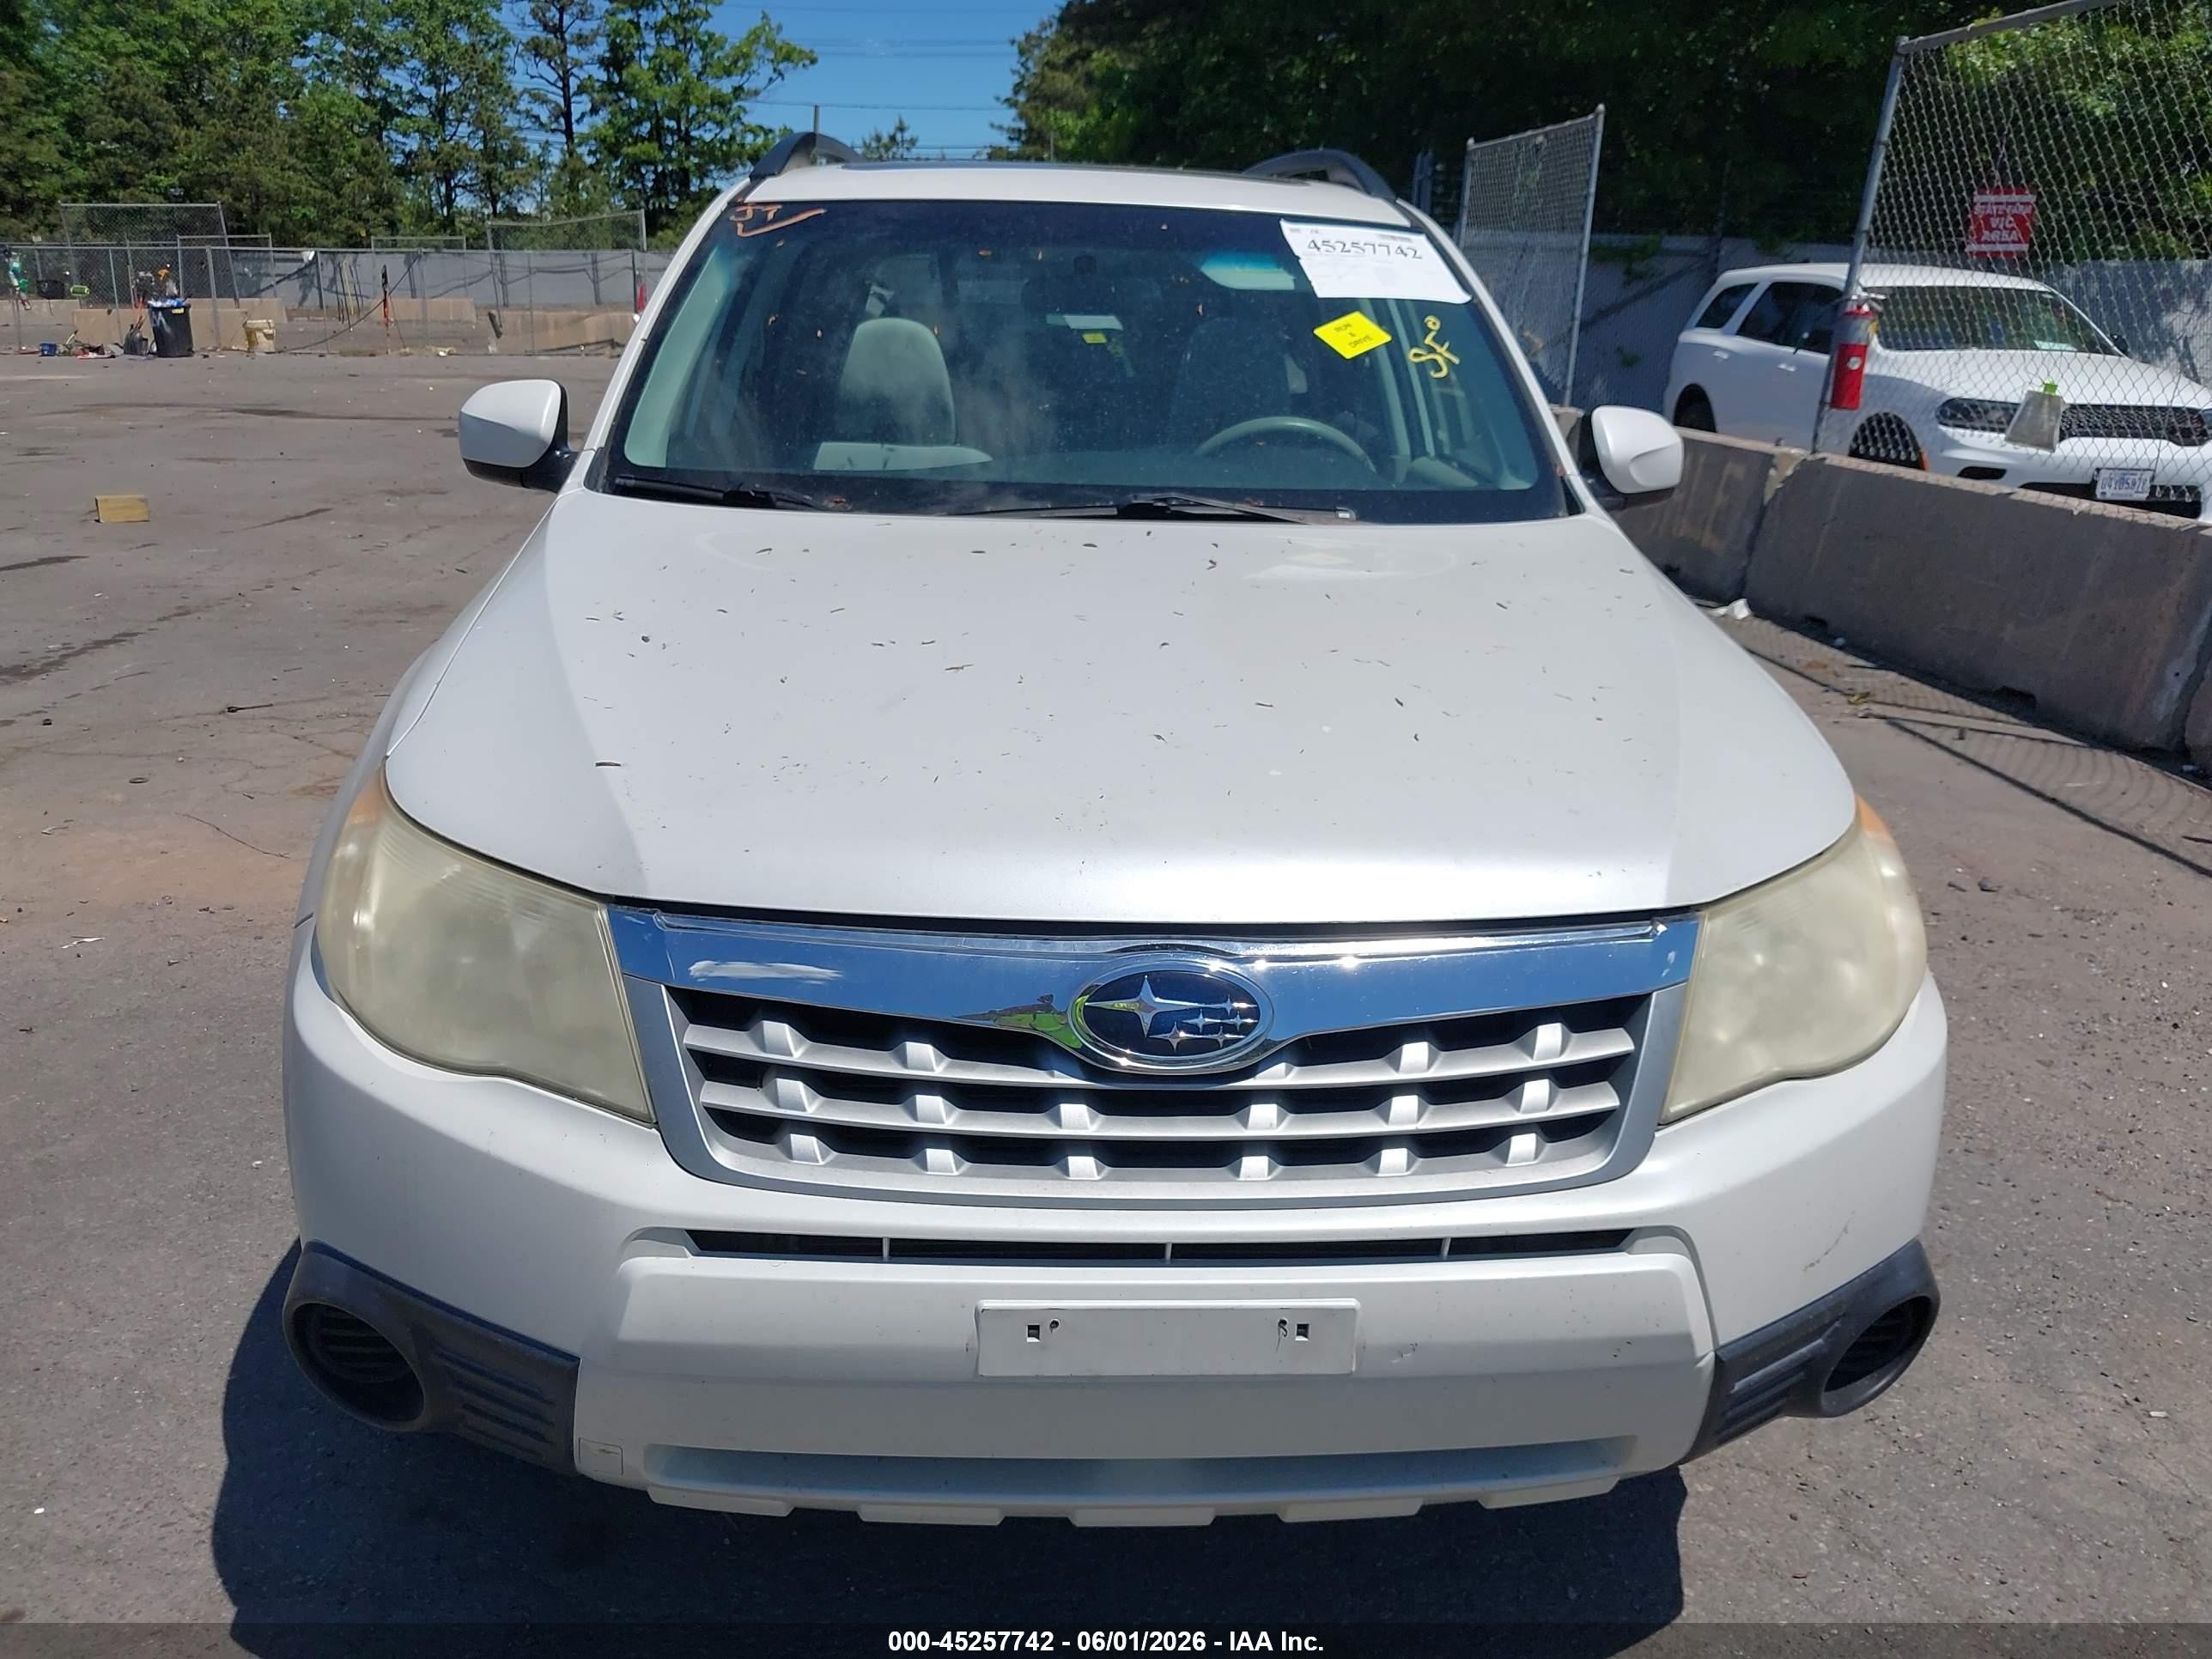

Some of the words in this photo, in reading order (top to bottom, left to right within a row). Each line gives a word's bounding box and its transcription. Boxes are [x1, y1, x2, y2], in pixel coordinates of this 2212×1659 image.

[1990, 216, 2014, 228] VIC
[1981, 230, 2019, 241] AREA
[1308, 239, 1423, 259] 45257742
[1334, 322, 1352, 333] RUN
[1347, 334, 1374, 349] DRIVE
